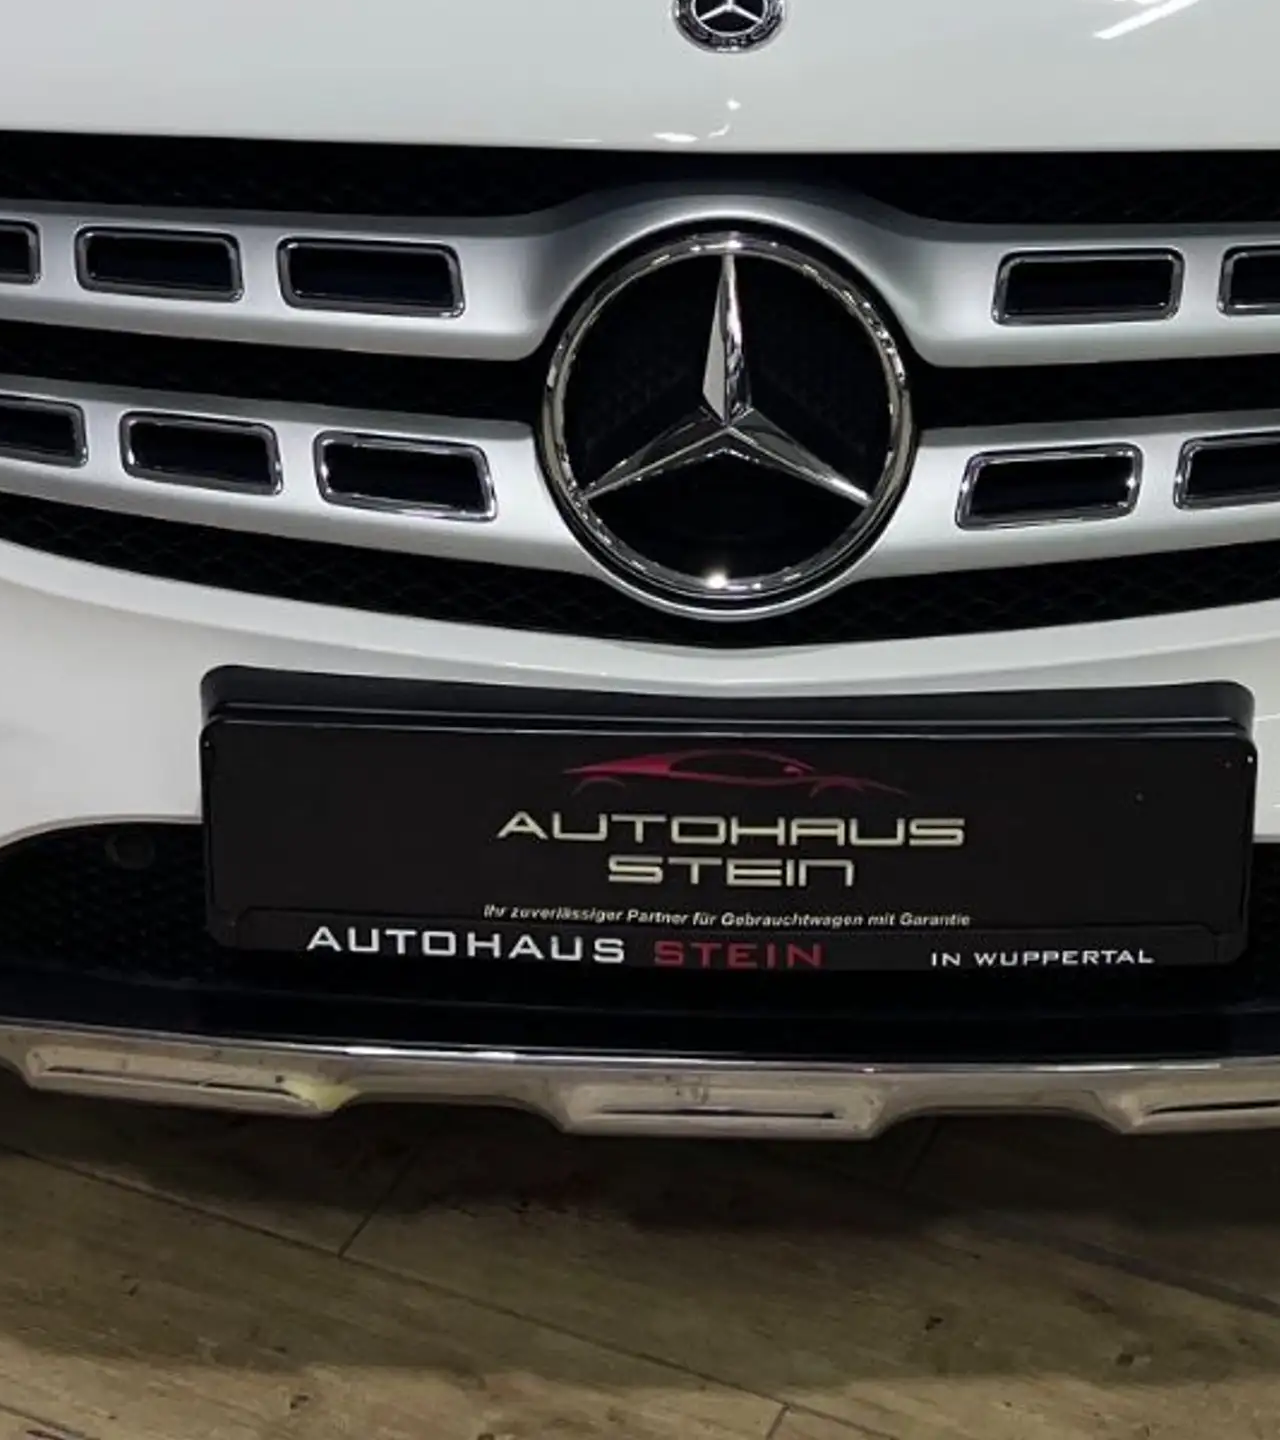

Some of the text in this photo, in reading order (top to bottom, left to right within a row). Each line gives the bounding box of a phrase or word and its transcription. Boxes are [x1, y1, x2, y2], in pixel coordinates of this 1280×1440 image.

[497, 811, 965, 846] AUTOHAUS
[608, 855, 854, 887] STEIN
[483, 904, 971, 929] Ihr zuverlässiger Partner für Gebrauchtwagen mit Garantie
[307, 924, 1155, 969] AUTOHAUS STEIN IN WUPPERTAL
